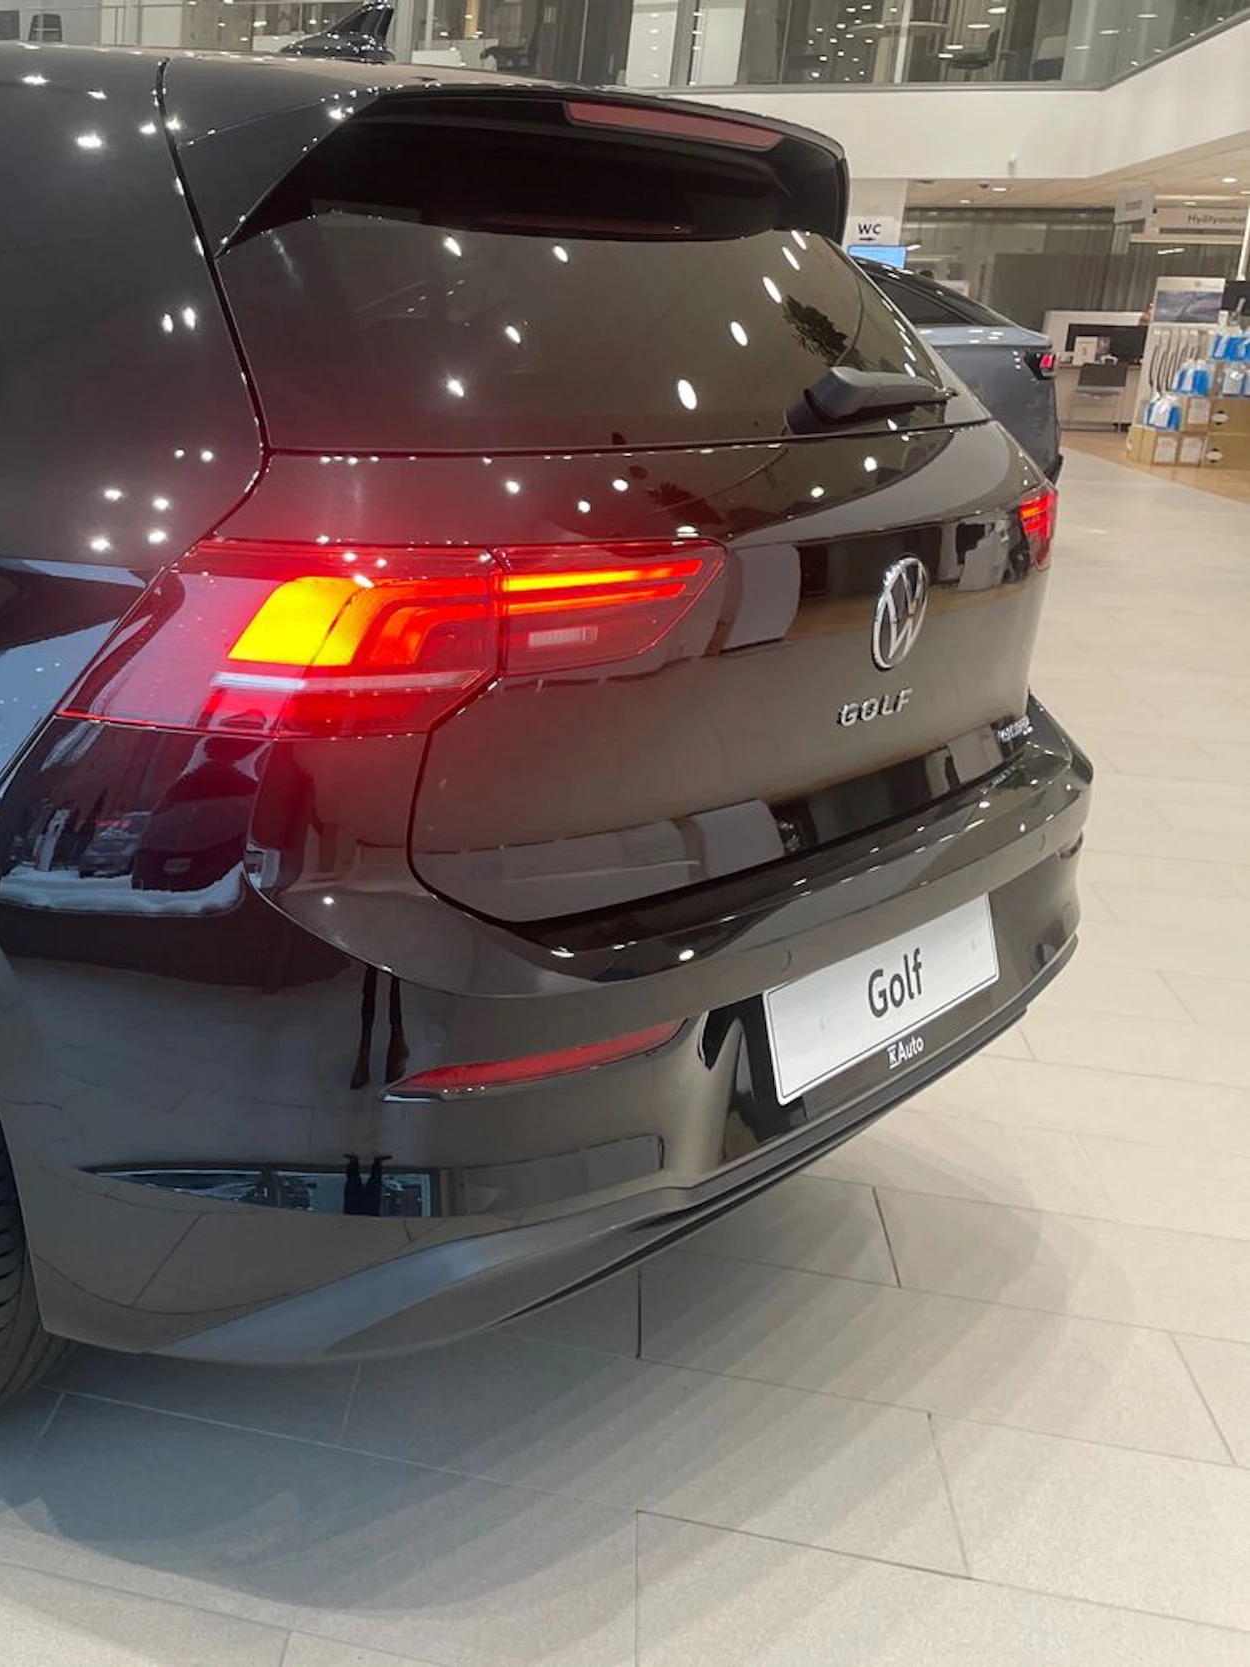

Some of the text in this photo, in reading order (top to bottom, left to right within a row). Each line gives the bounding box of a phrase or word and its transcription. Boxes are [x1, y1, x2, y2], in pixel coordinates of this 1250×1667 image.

[858, 223, 882, 235] WC
[839, 687, 913, 726] GOLF
[867, 947, 923, 1019] Golf
